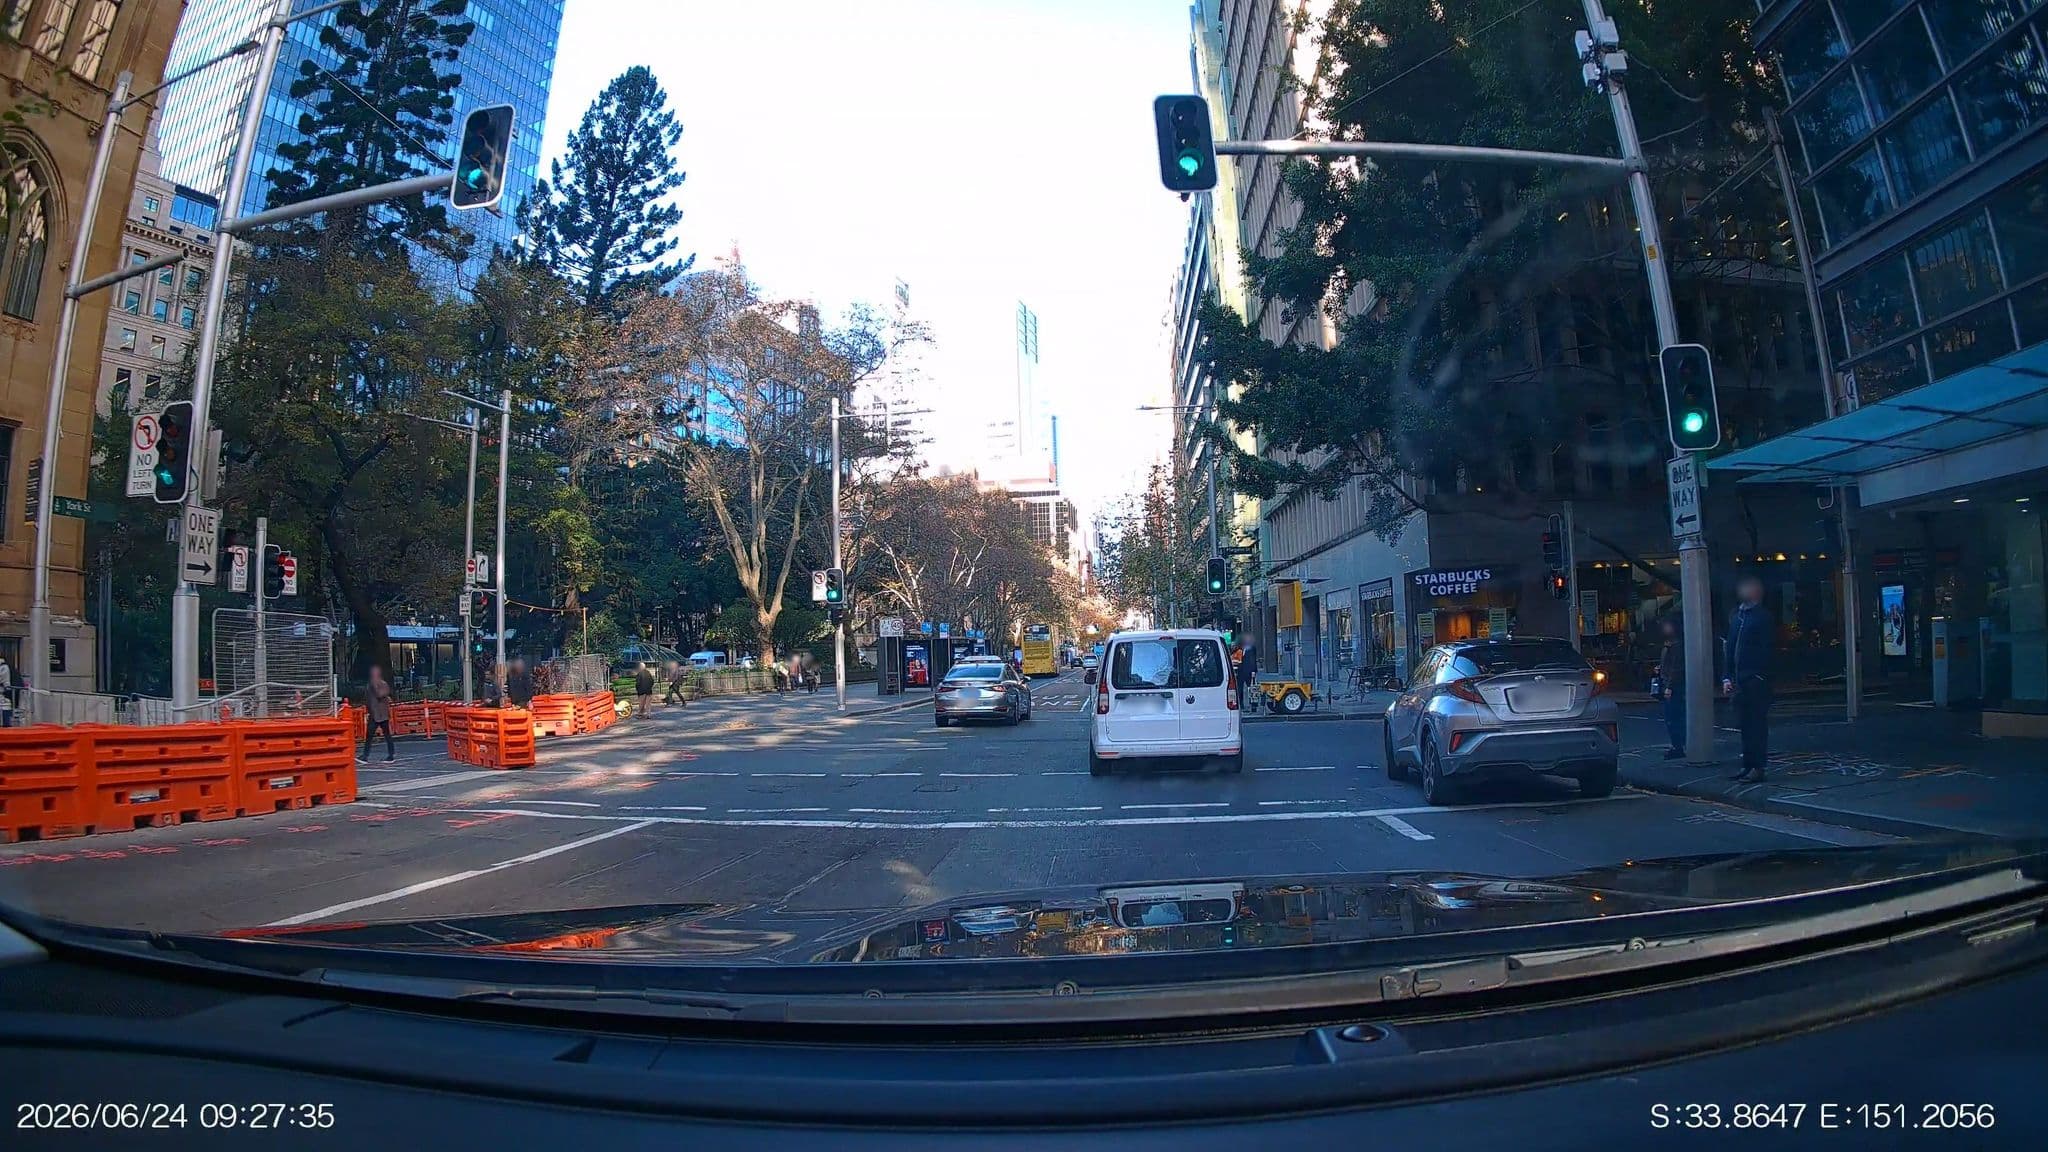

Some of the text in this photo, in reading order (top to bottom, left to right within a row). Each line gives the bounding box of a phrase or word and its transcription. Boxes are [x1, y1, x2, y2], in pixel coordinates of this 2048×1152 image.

[136, 453, 152, 466] NO
[132, 469, 152, 479] LEFT
[132, 481, 152, 490] TURN
[1673, 487, 1696, 508] WAY
[65, 500, 82, 511] York
[188, 513, 214, 534] ONE
[187, 535, 214, 556] WAY
[1415, 569, 1491, 585] STARBUCKS
[1430, 583, 1478, 596] COFFEE
